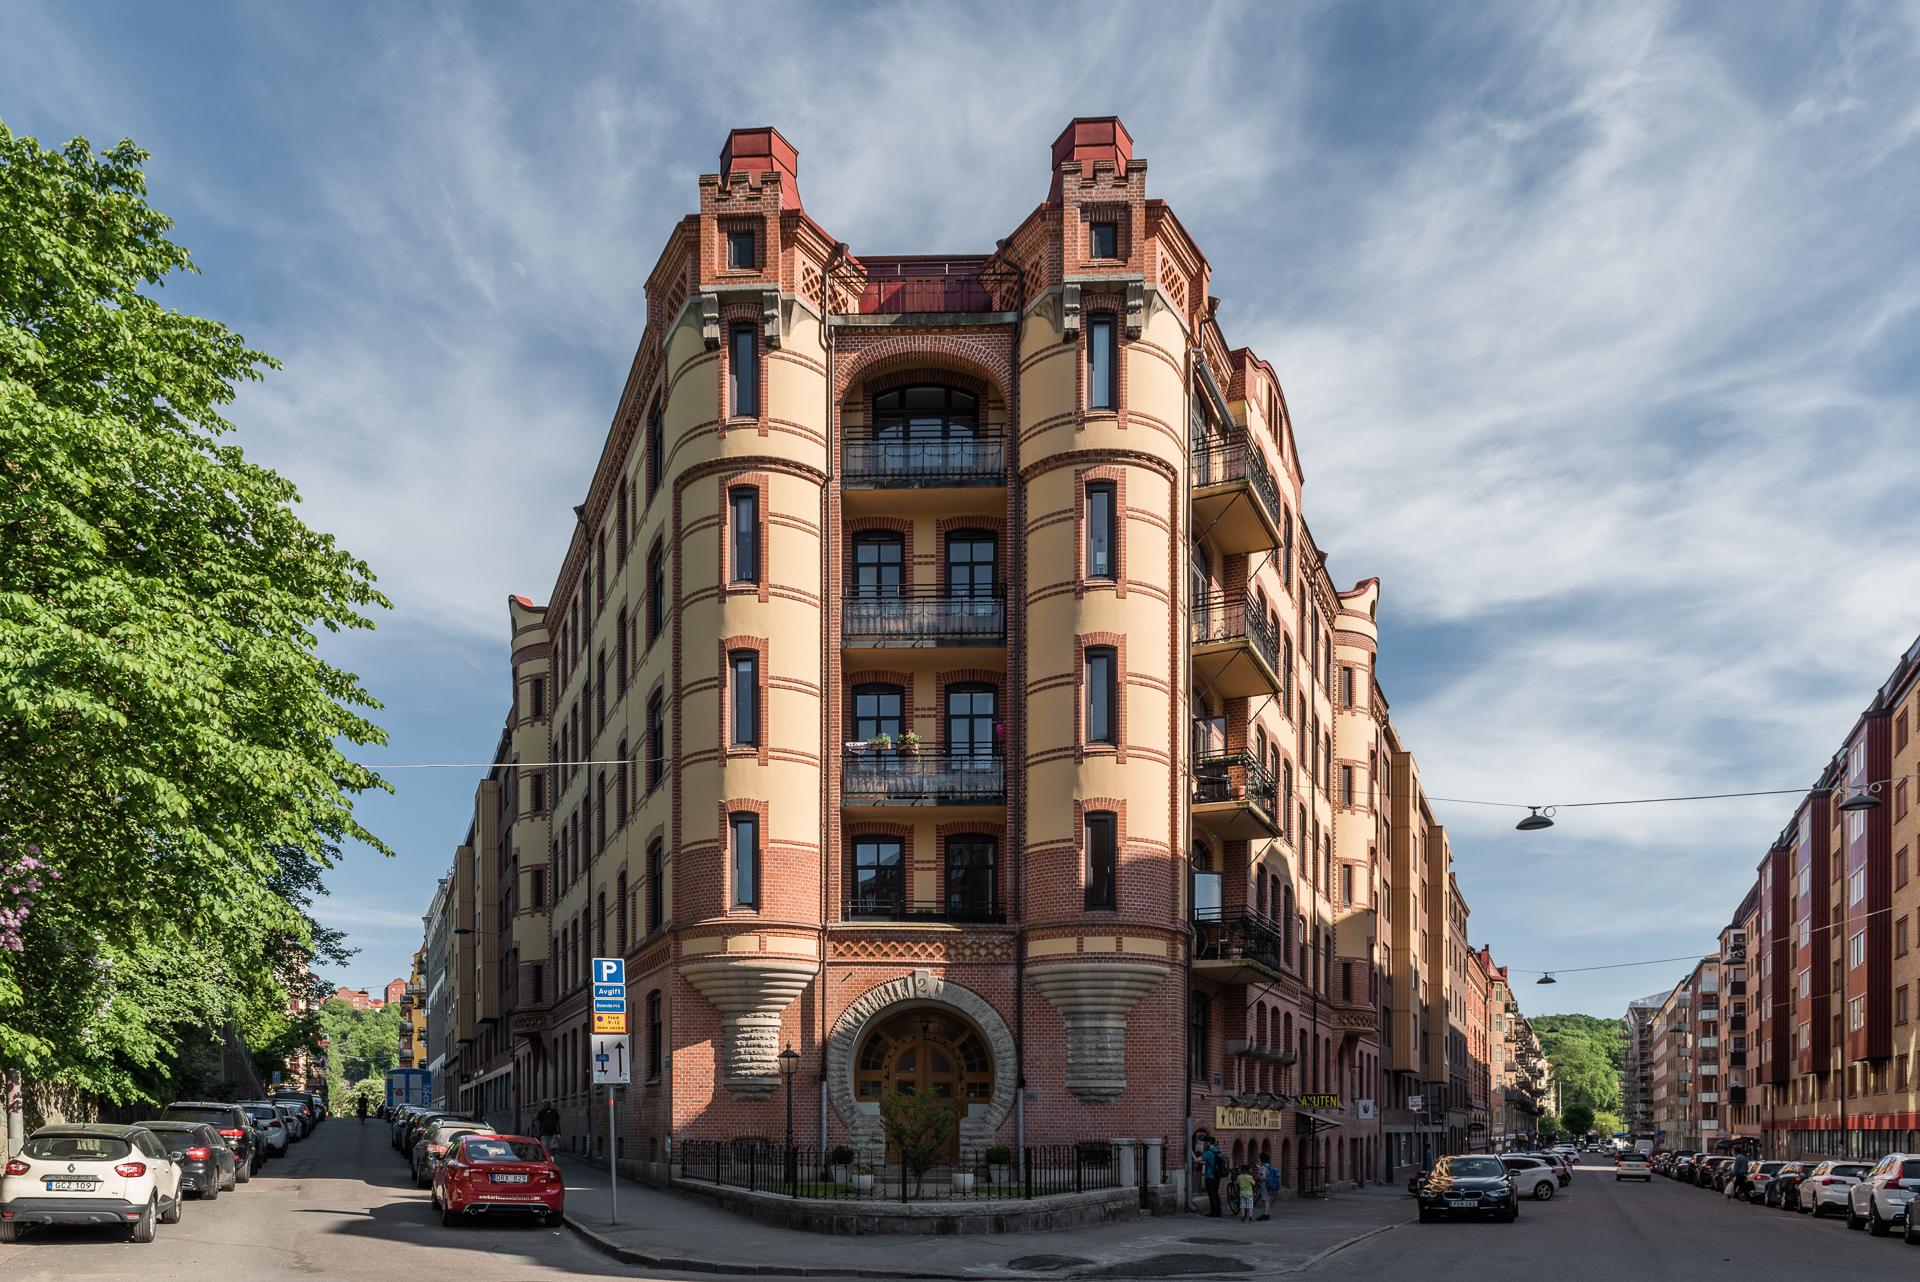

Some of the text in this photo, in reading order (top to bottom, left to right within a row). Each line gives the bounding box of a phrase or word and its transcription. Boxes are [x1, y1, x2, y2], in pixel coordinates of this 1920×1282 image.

[602, 961, 617, 982] P
[598, 988, 621, 996] Avgift
[917, 978, 928, 993] 2
[1228, 1109, 1261, 1127] CYKELAKUTEN
